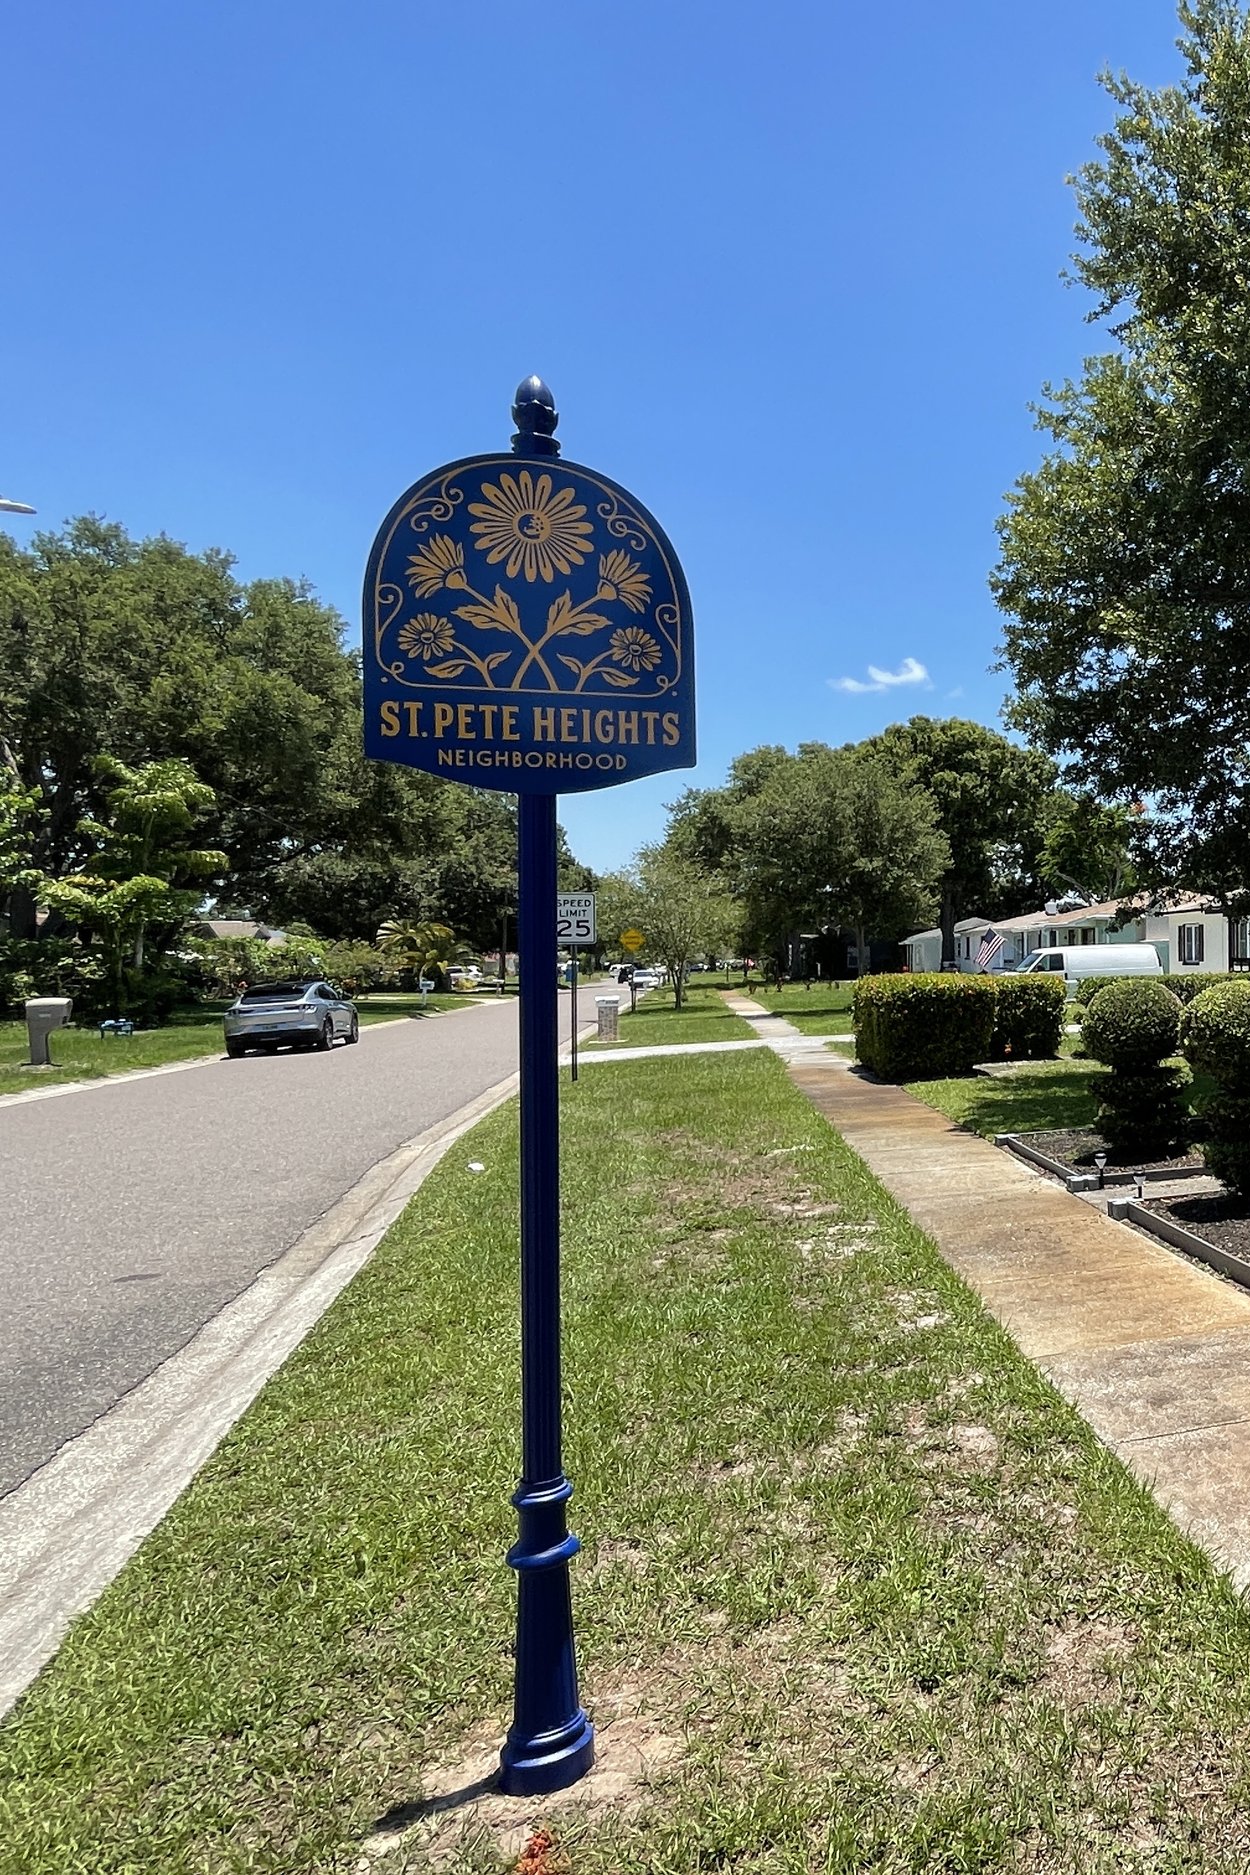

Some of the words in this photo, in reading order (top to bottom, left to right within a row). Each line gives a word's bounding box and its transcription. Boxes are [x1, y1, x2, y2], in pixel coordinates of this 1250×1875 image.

[380, 700, 428, 737] ST.
[434, 703, 520, 741] PETE
[533, 706, 680, 746] HEIGHTS
[438, 749, 627, 770] NEIGHBORHOOD
[557, 899, 591, 907] SPEED
[560, 909, 587, 917] LIMIT
[557, 919, 590, 937] 25
